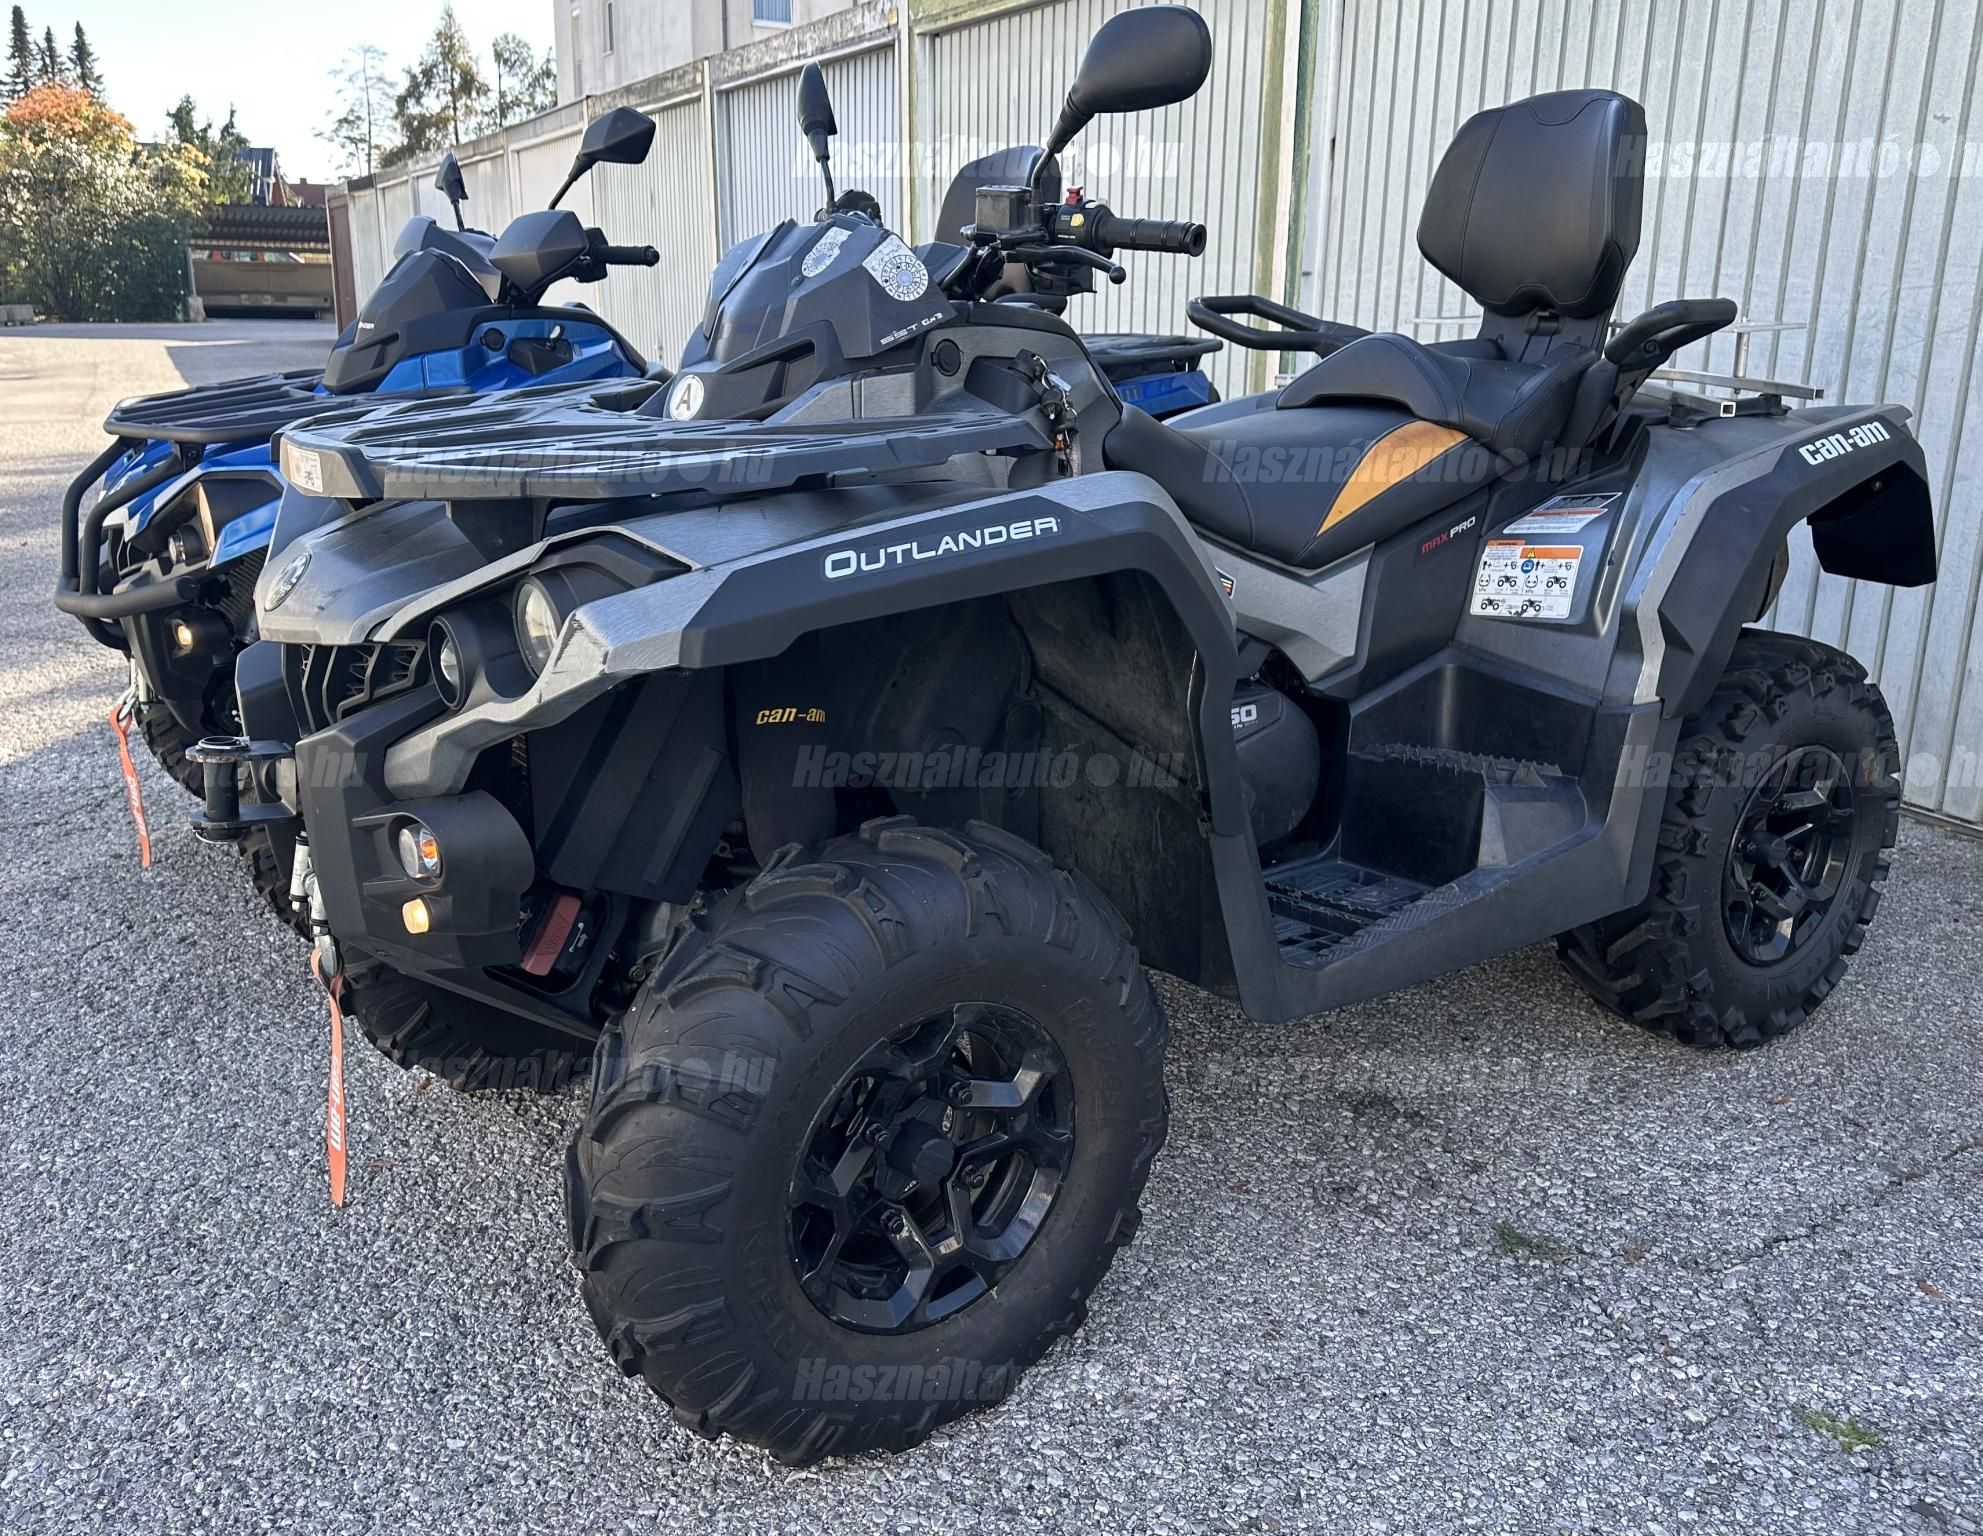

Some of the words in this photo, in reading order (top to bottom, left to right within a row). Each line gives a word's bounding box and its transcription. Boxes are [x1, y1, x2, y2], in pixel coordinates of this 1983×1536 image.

[675, 383, 692, 411] A
[1799, 421, 1891, 466] can-am
[824, 516, 1059, 579] OUTLANDER
[1422, 531, 1449, 554] MAX
[1450, 516, 1476, 538] PRO
[755, 707, 826, 725] can-am
